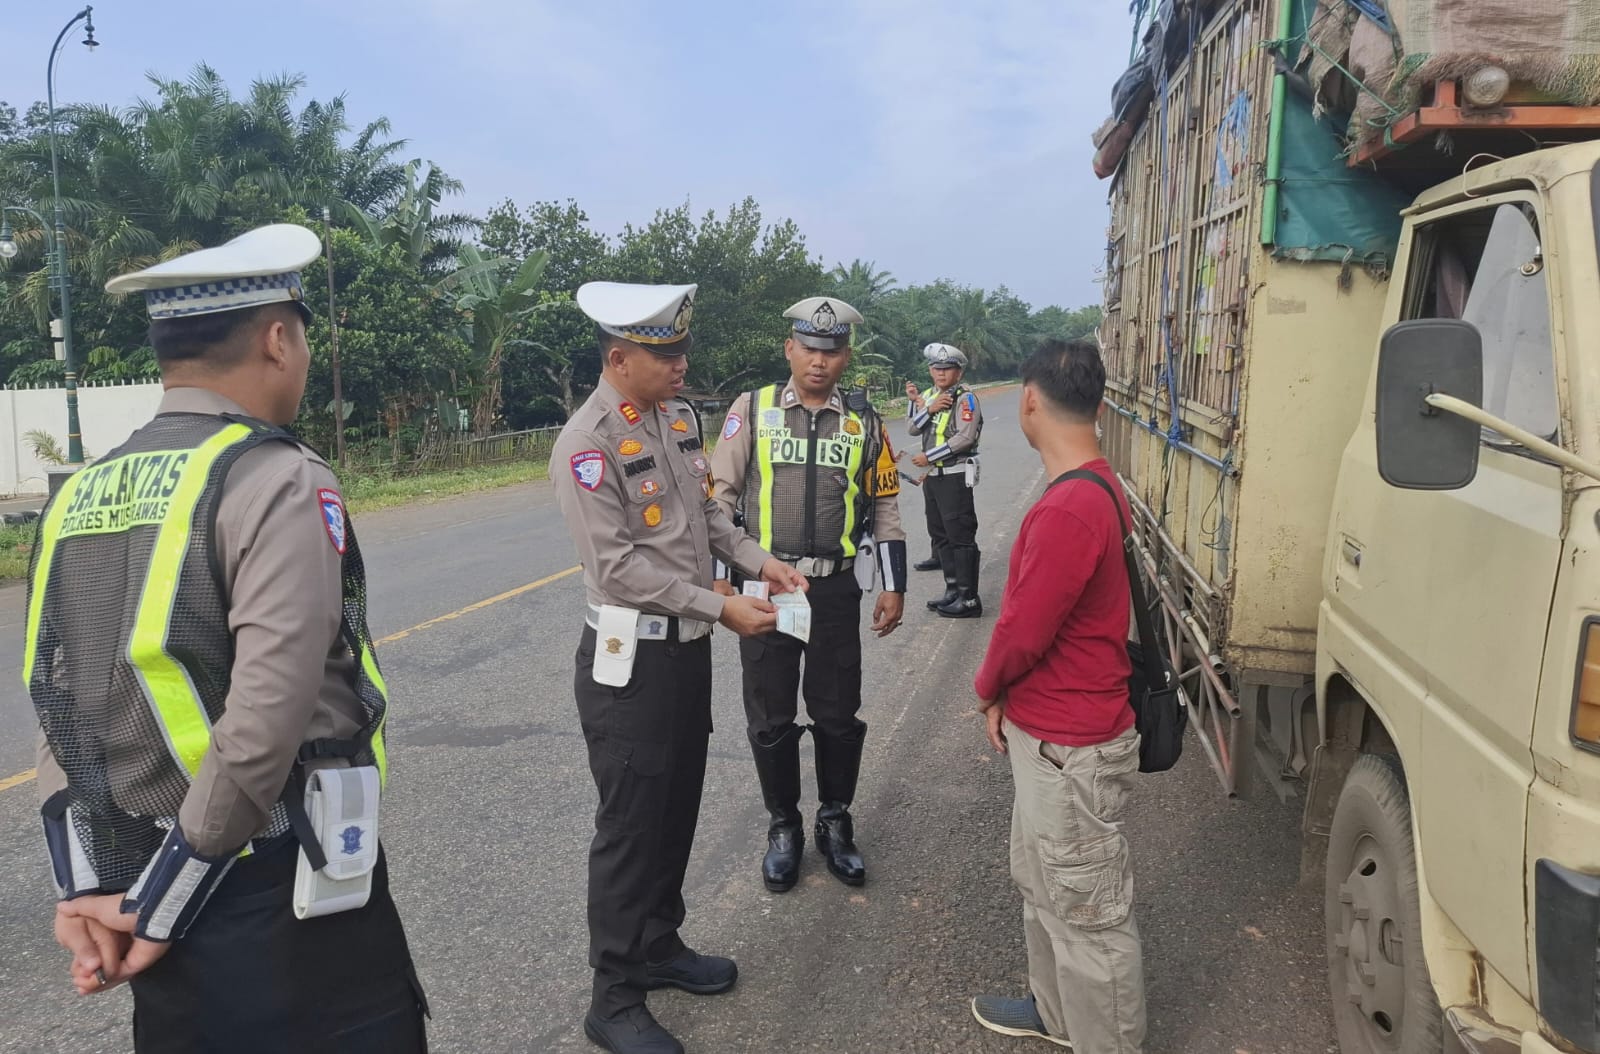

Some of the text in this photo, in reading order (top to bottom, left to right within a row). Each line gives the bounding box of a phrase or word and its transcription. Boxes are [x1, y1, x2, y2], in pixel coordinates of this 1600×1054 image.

[759, 428, 790, 438] DICKY
[833, 433, 863, 448] POLRI
[67, 453, 188, 514] SATLANTAS
[60, 510, 103, 536] POLRES
